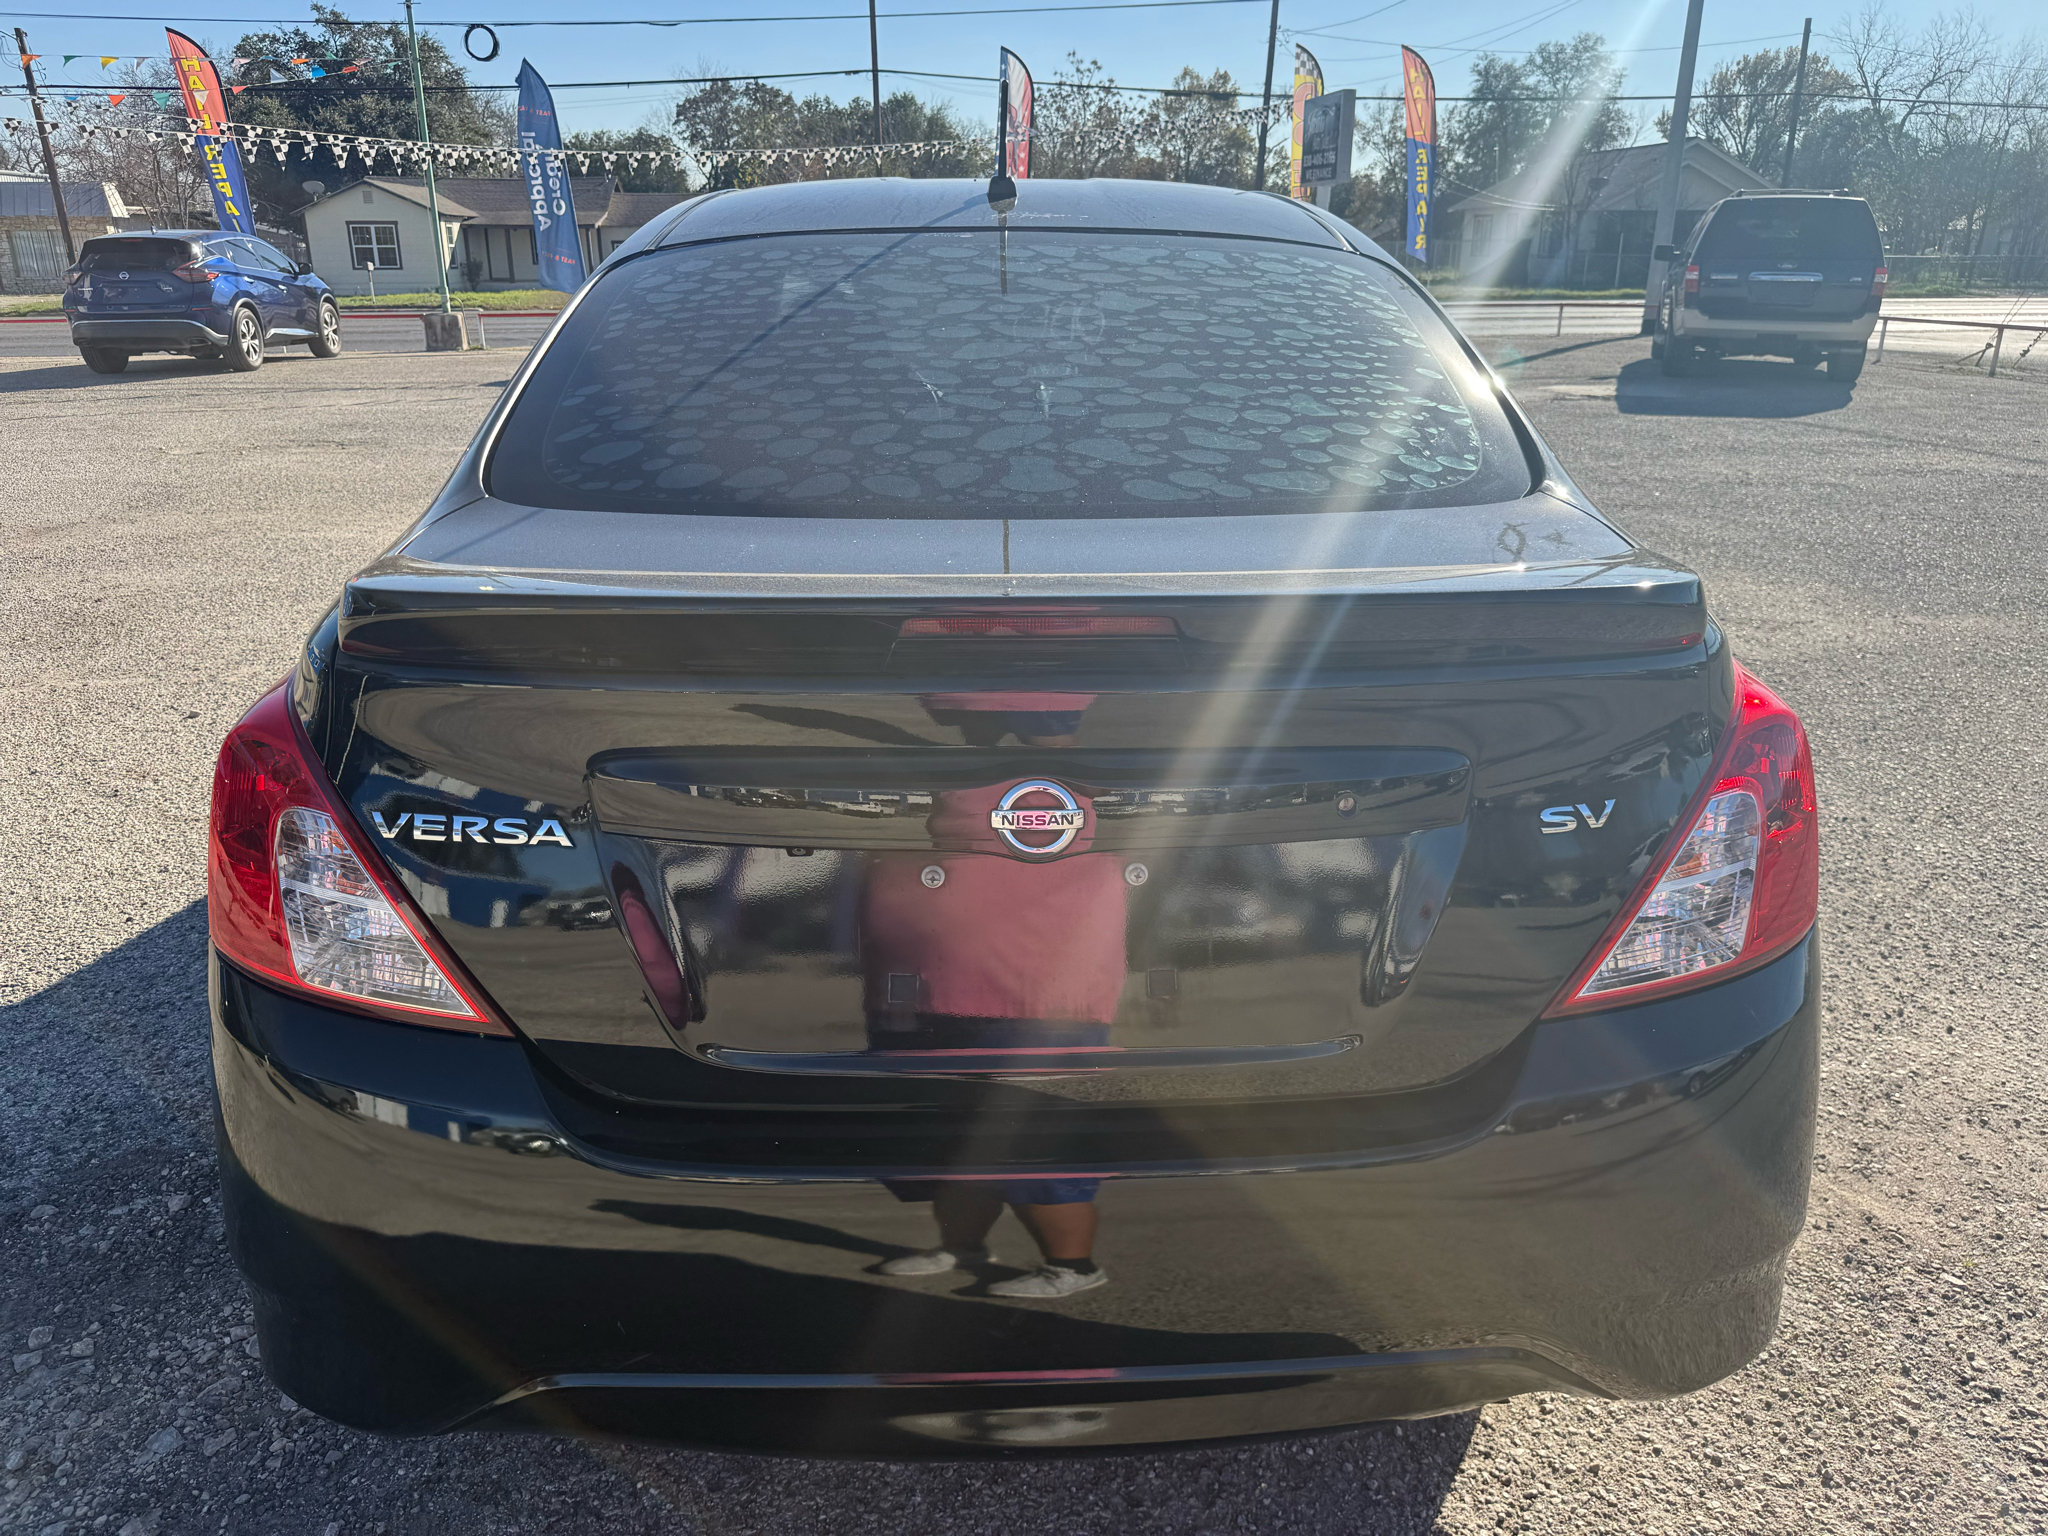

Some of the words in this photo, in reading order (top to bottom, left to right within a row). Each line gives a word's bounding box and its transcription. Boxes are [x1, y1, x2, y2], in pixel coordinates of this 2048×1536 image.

[371, 811, 574, 848] VERSA
[1001, 814, 1074, 826] NISSAN
[1540, 798, 1616, 834] SV
